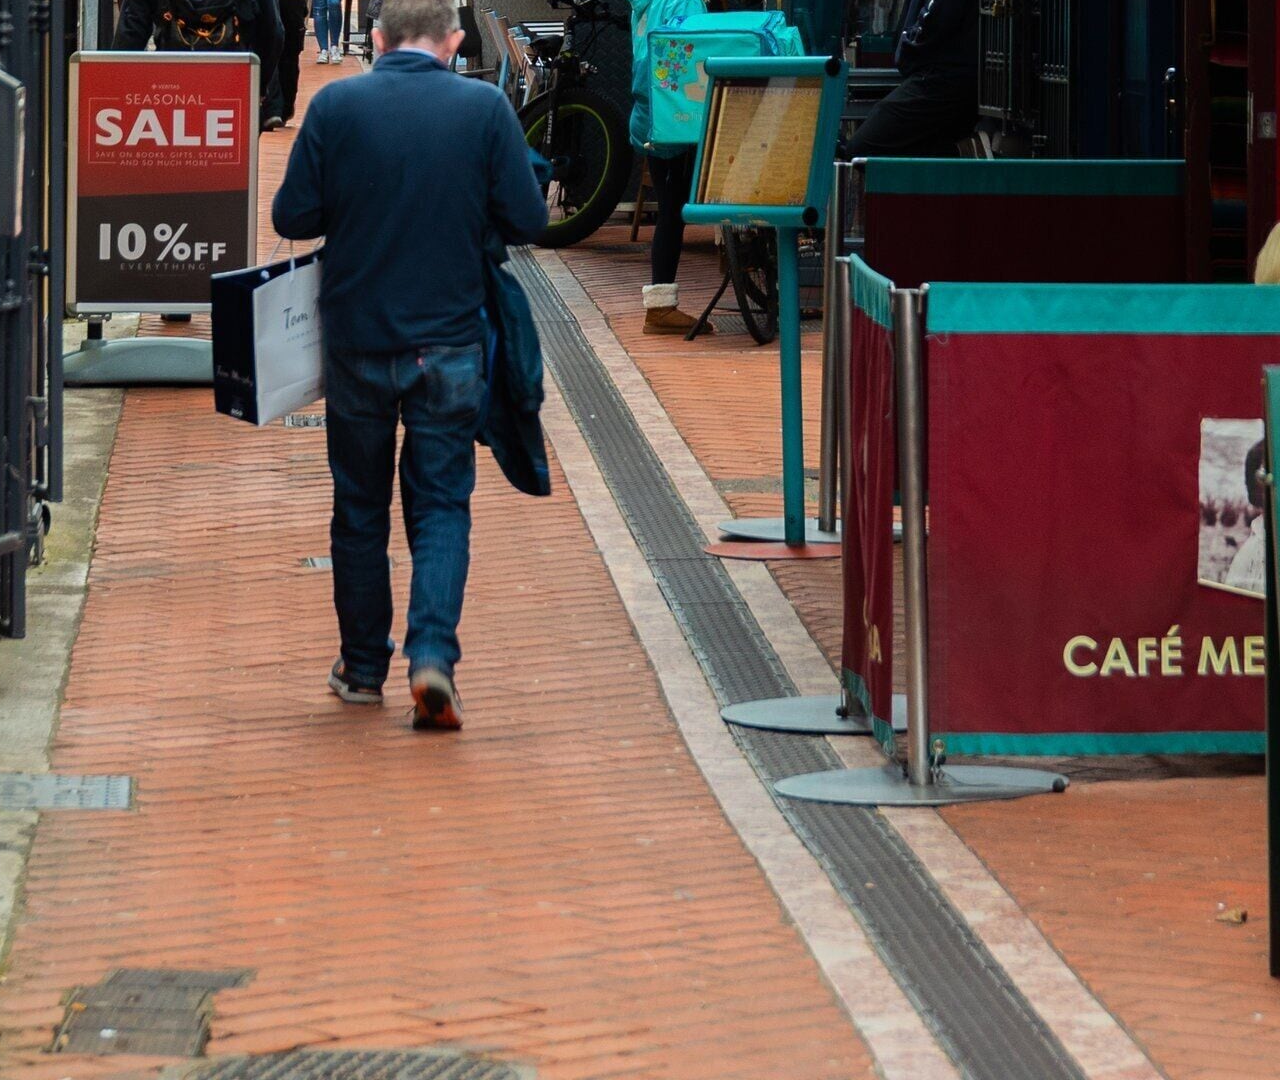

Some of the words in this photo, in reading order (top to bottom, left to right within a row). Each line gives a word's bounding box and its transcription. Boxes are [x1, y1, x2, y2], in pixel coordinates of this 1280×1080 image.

[125, 93, 206, 106] SEASONAL
[95, 108, 234, 147] SALE
[95, 150, 115, 159] SAVE
[119, 150, 133, 159] ON
[198, 151, 234, 160] STATUES
[119, 159, 139, 167] AND
[141, 159, 154, 167] SO
[157, 159, 182, 167] MUCH
[185, 159, 209, 167] MORE
[120, 262, 206, 271] EVERYTHING
[282, 307, 309, 331] Tom
[1063, 624, 1183, 677] CAFÉ
